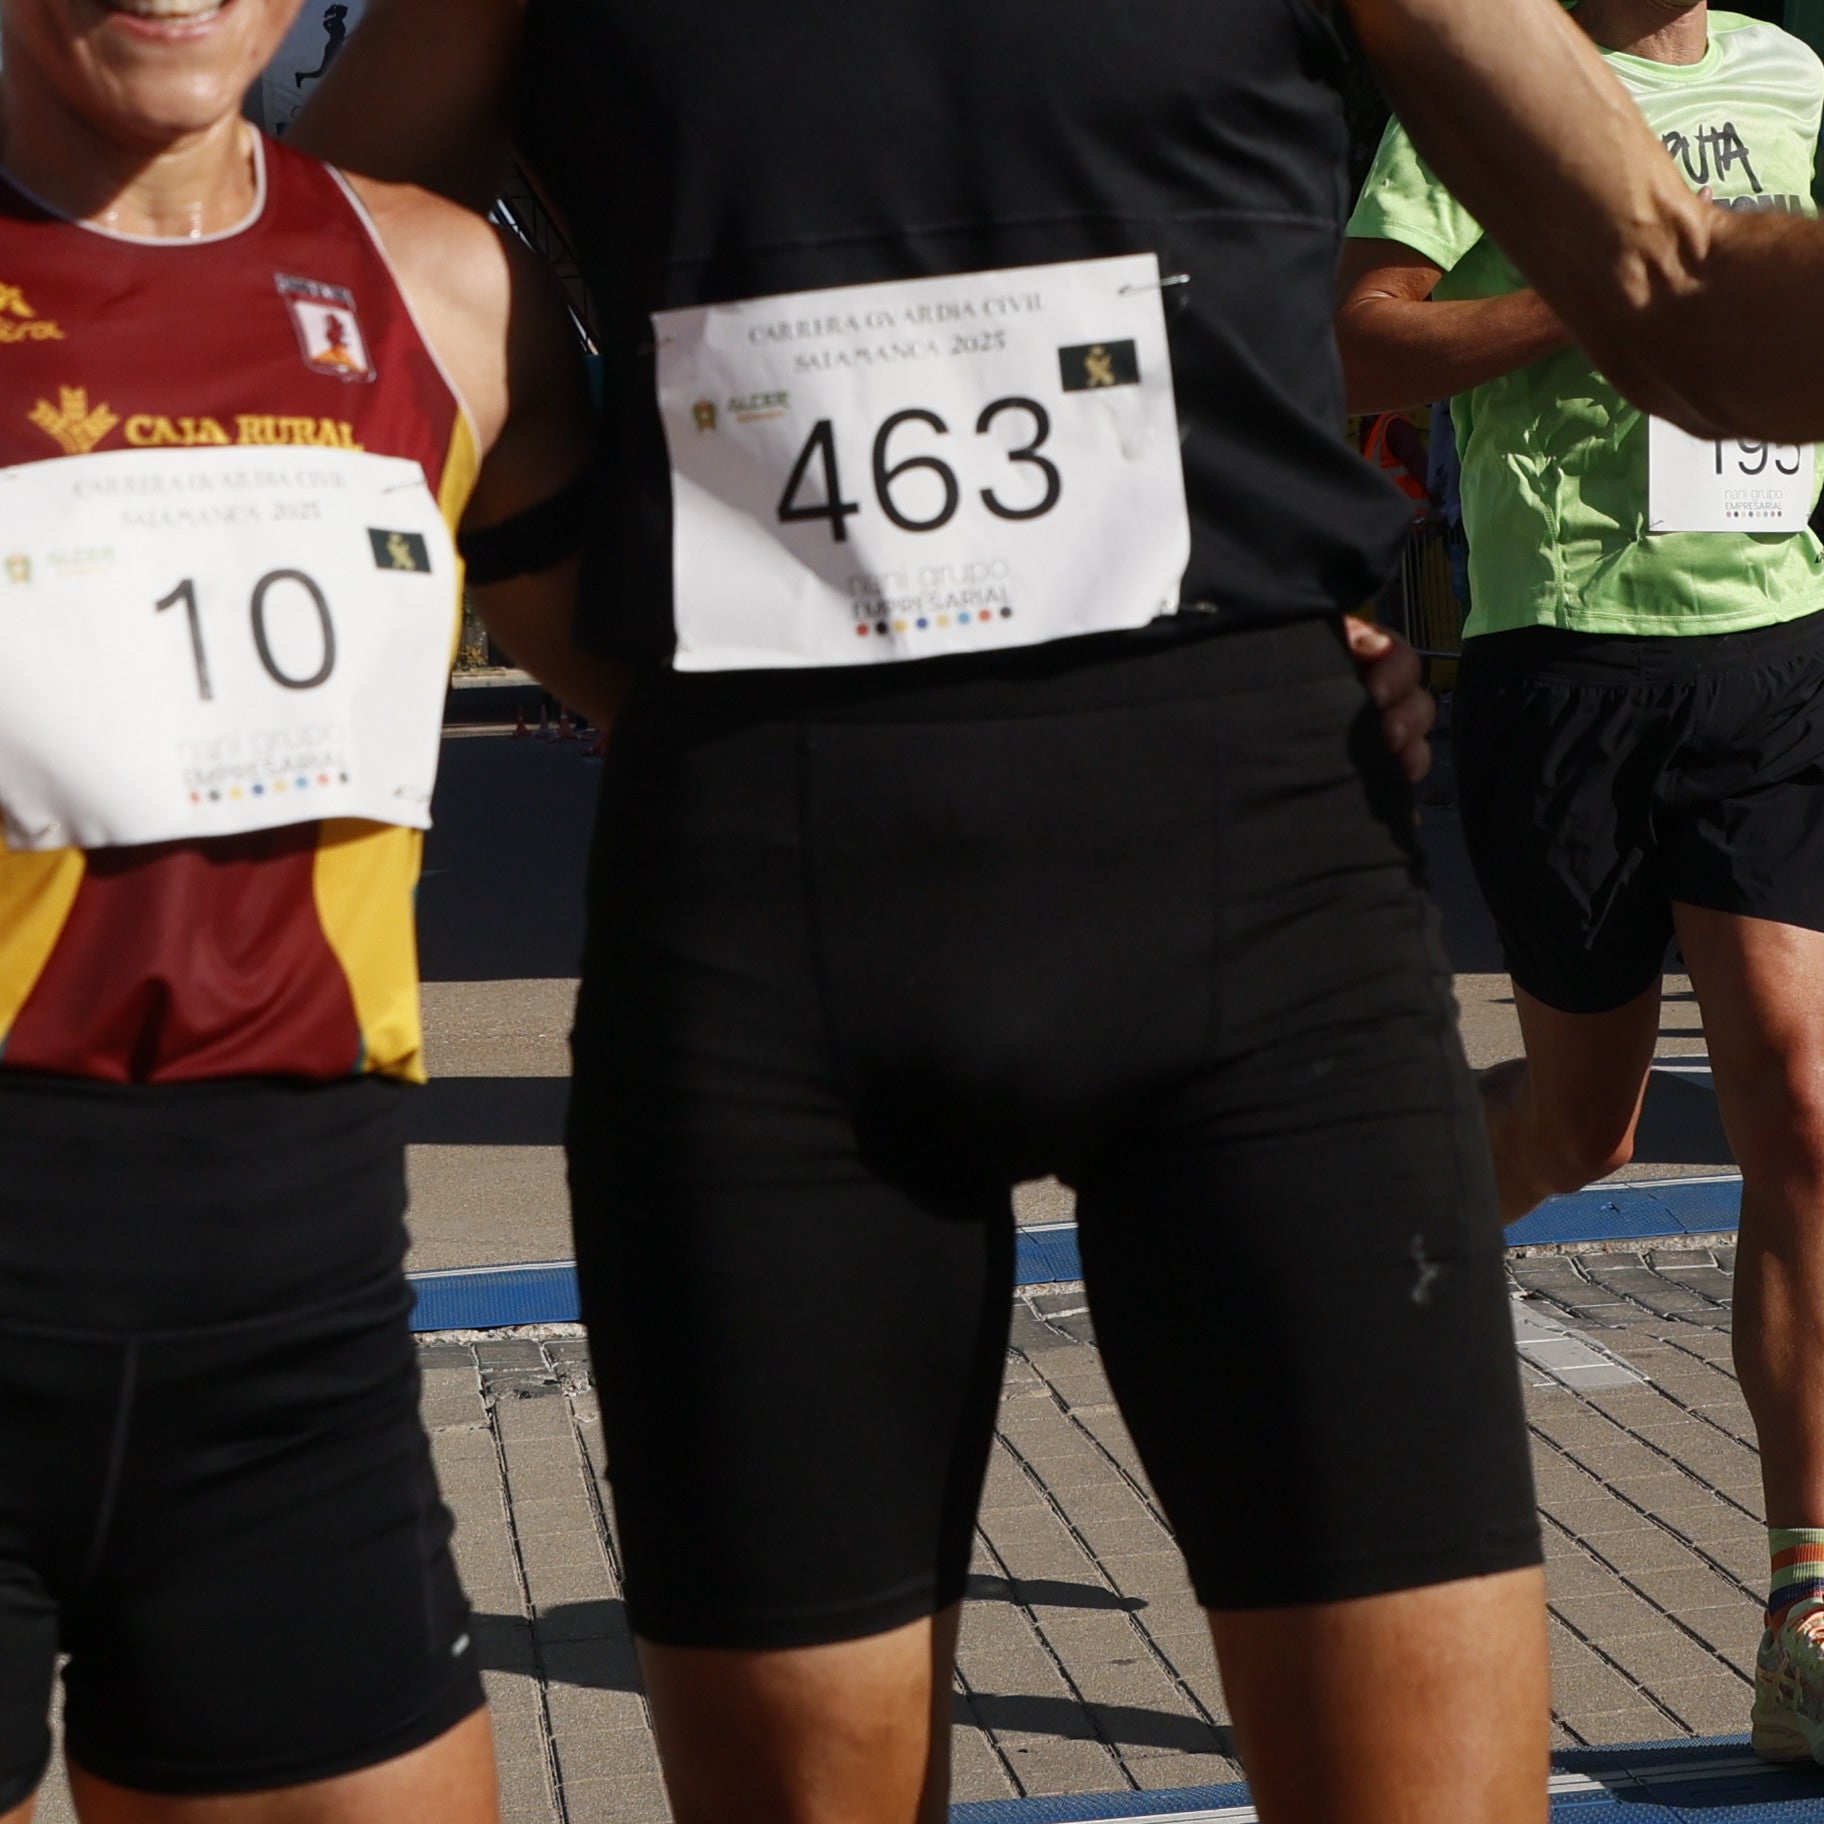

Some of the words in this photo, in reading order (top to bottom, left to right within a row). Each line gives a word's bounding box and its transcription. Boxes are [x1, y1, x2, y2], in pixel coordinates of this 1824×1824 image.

[1662, 121, 1763, 194] PUTA
[793, 344, 940, 375] SALAMANCA
[950, 329, 1006, 357] 2025
[125, 414, 230, 446] CAJA
[235, 414, 364, 452] RURAL
[778, 395, 1062, 543] 463
[1725, 501, 1782, 511] EMPRESARIAL
[1751, 488, 1784, 504] grupo
[852, 587, 1010, 618] EMPRESARIAL
[154, 568, 336, 701] 10
